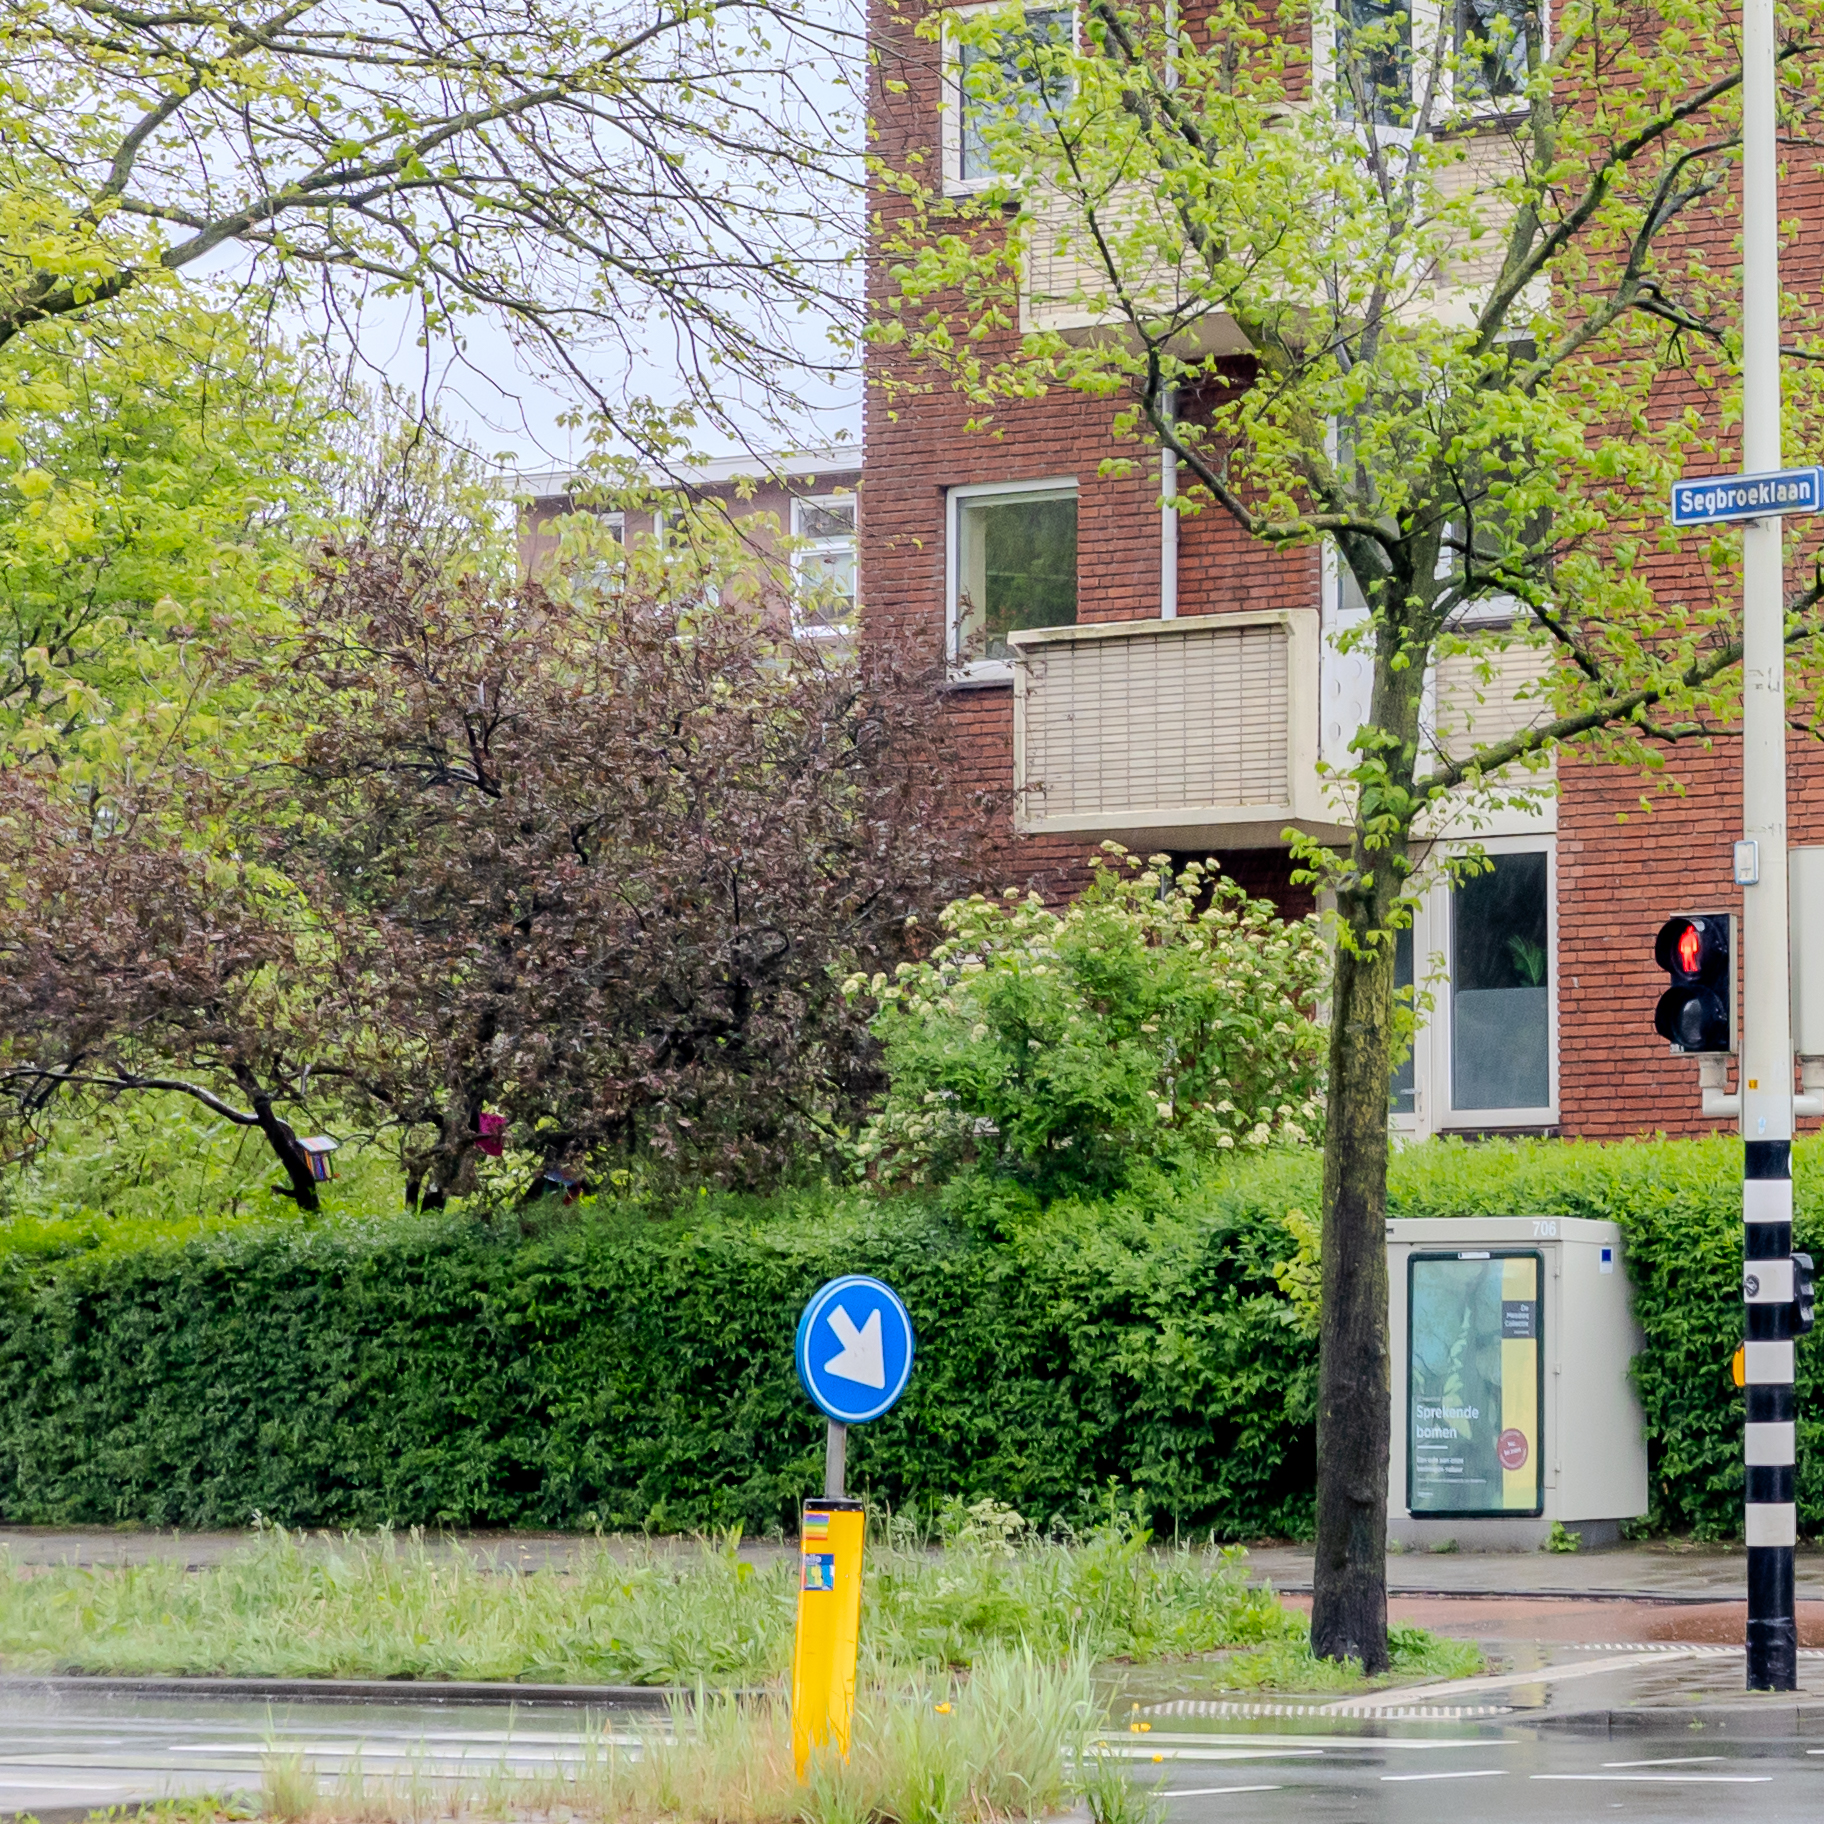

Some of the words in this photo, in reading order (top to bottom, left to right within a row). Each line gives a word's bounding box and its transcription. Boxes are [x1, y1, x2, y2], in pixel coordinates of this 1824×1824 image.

[1681, 481, 1811, 516] Segbroeklaan
[1532, 1220, 1557, 1237] 706
[1416, 1404, 1480, 1422] Sprekende
[1416, 1424, 1458, 1439] bomen
